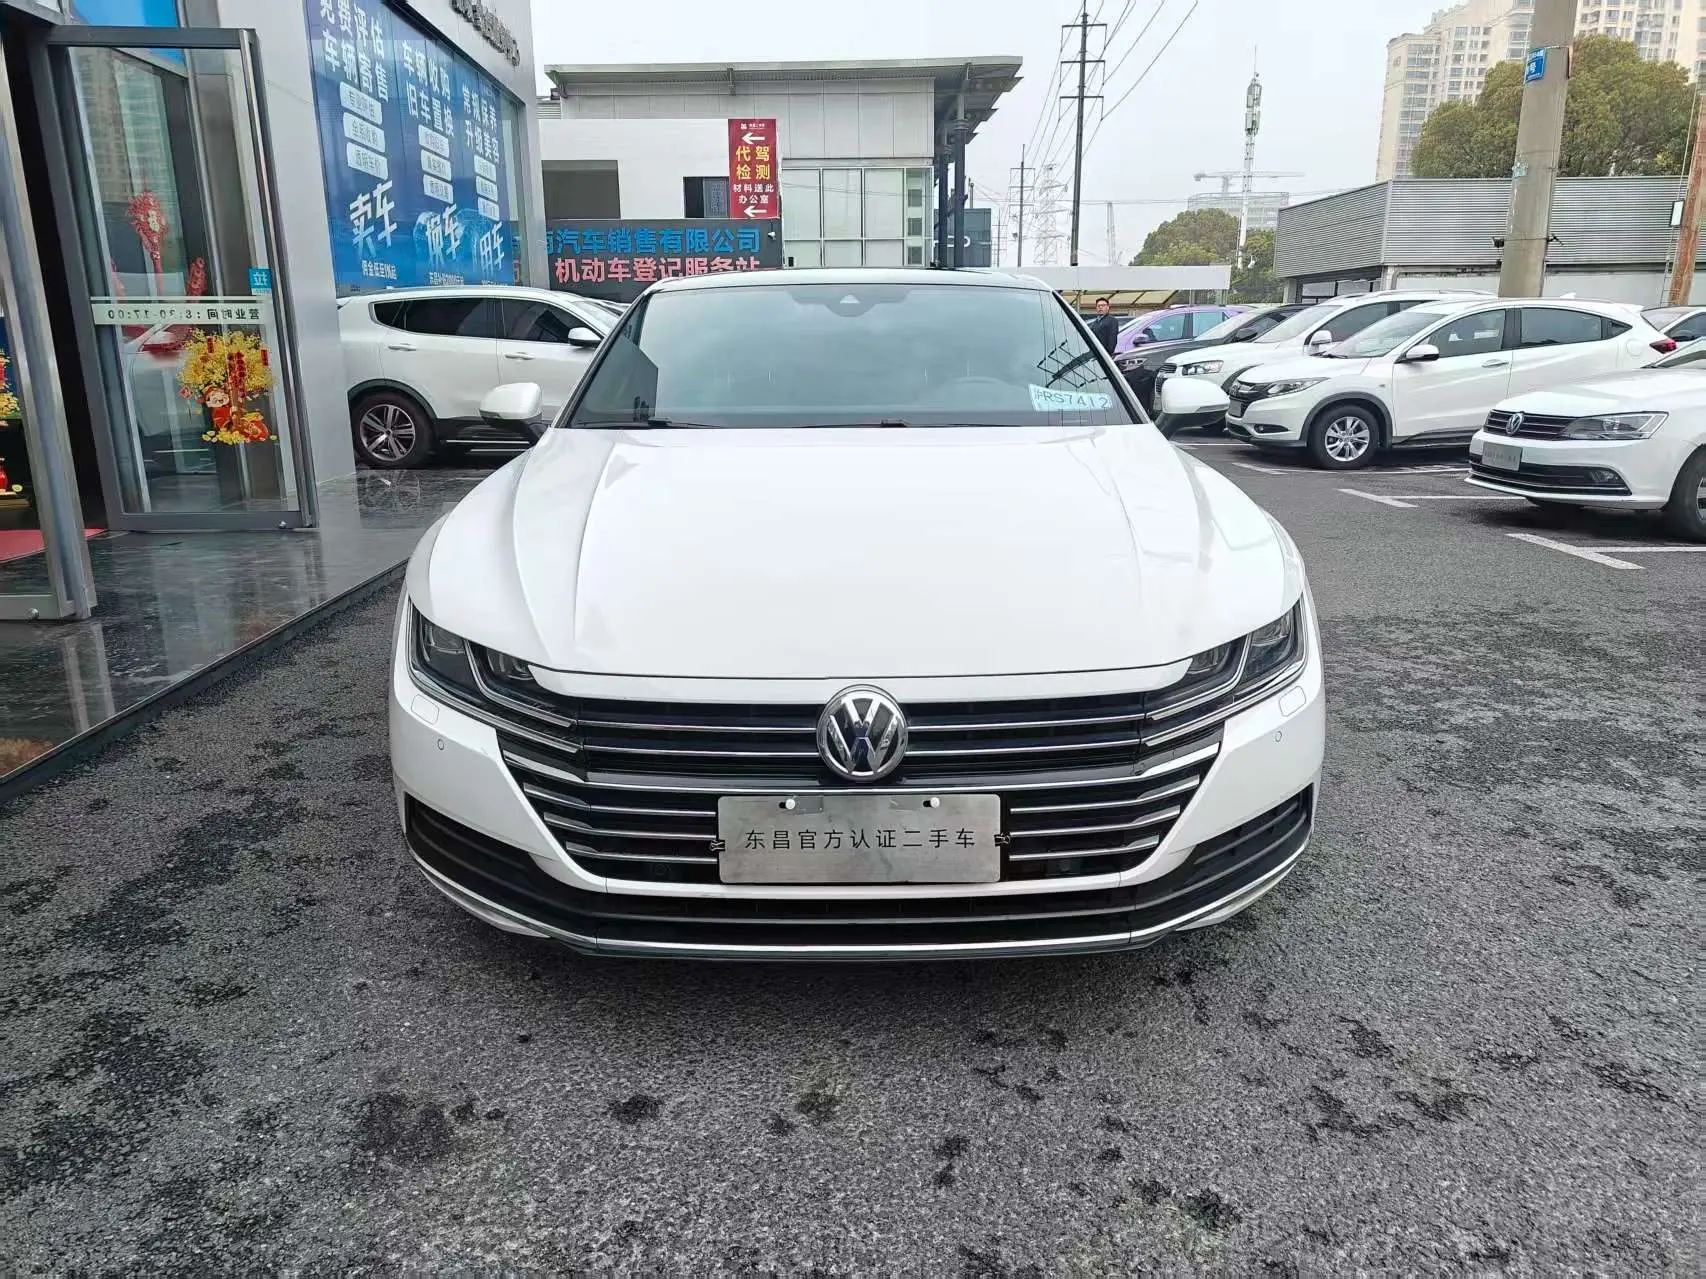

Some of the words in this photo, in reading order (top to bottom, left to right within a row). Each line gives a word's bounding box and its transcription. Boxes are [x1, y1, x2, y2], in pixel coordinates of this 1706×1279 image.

[322, 29, 389, 103] 车辆寄售
[402, 40, 451, 101] 车辆收购
[406, 80, 455, 137] 旧车置换
[735, 145, 771, 162] 代驾
[736, 163, 771, 180] 检测
[733, 183, 775, 194] 材料送此
[738, 194, 769, 204] 办公室
[350, 180, 398, 258] 卖车
[480, 221, 505, 276] 用车
[547, 227, 761, 255] 汽车销售有限公司
[555, 256, 761, 283] 机动车登记服务站
[744, 828, 976, 850] 东昌官方认证二手车
